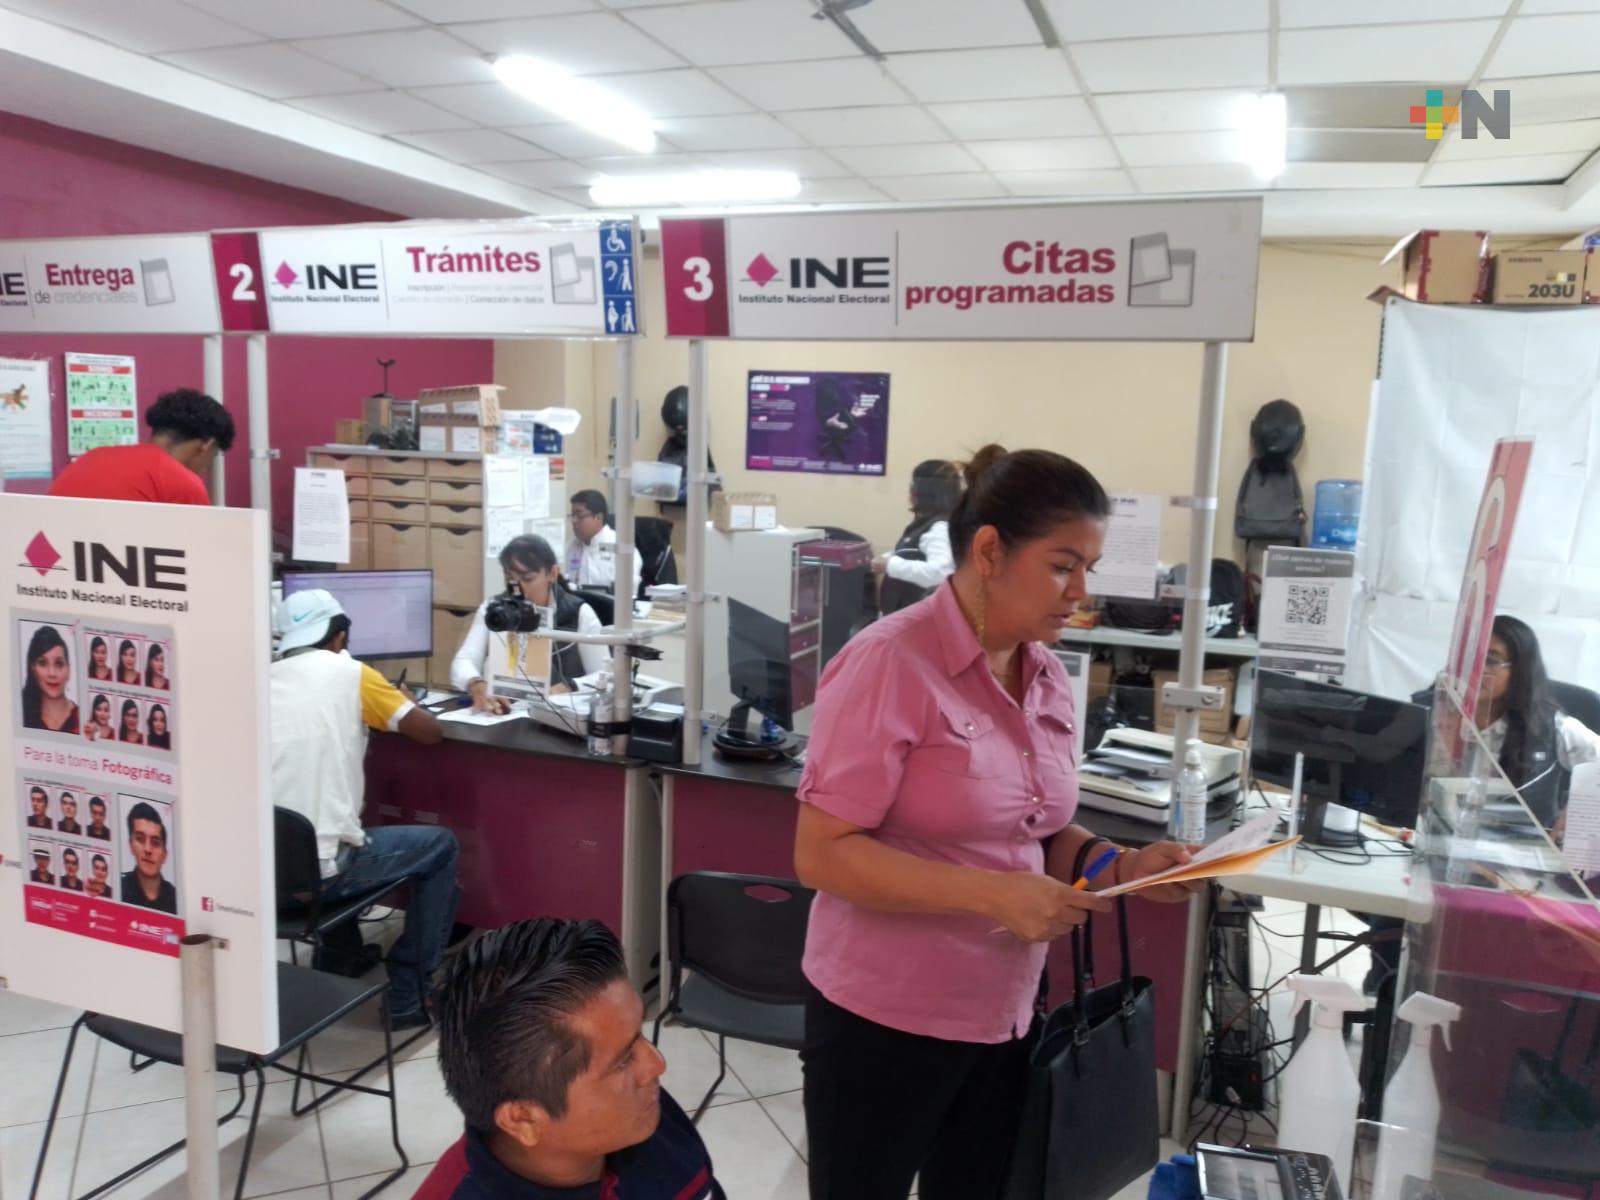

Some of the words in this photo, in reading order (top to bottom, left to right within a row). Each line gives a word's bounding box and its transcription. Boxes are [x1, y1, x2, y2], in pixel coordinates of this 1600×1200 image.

[405, 244, 541, 273] Trámites
[789, 256, 891, 289] INE
[1002, 240, 1116, 275] Citas
[45, 262, 136, 292] Entrega
[228, 262, 258, 301] 2
[304, 263, 379, 291] INE
[682, 256, 715, 302] 3
[1527, 283, 1576, 298] 203U
[34, 288, 51, 304] de
[270, 294, 304, 303] Instituto
[306, 294, 341, 303] Nacional
[343, 294, 380, 303] Electoral
[738, 294, 784, 304] Instituto
[786, 294, 836, 304] Nacional
[838, 294, 891, 304] Electoral
[904, 278, 1116, 311] programadas
[73, 541, 188, 592] INE
[16, 583, 68, 600] Instituto
[71, 589, 126, 606] Nacional
[129, 595, 189, 613] Electoral
[23, 746, 52, 763] Para
[54, 751, 65, 765] la
[67, 755, 98, 771] toma
[101, 758, 172, 785] Fotográfica
